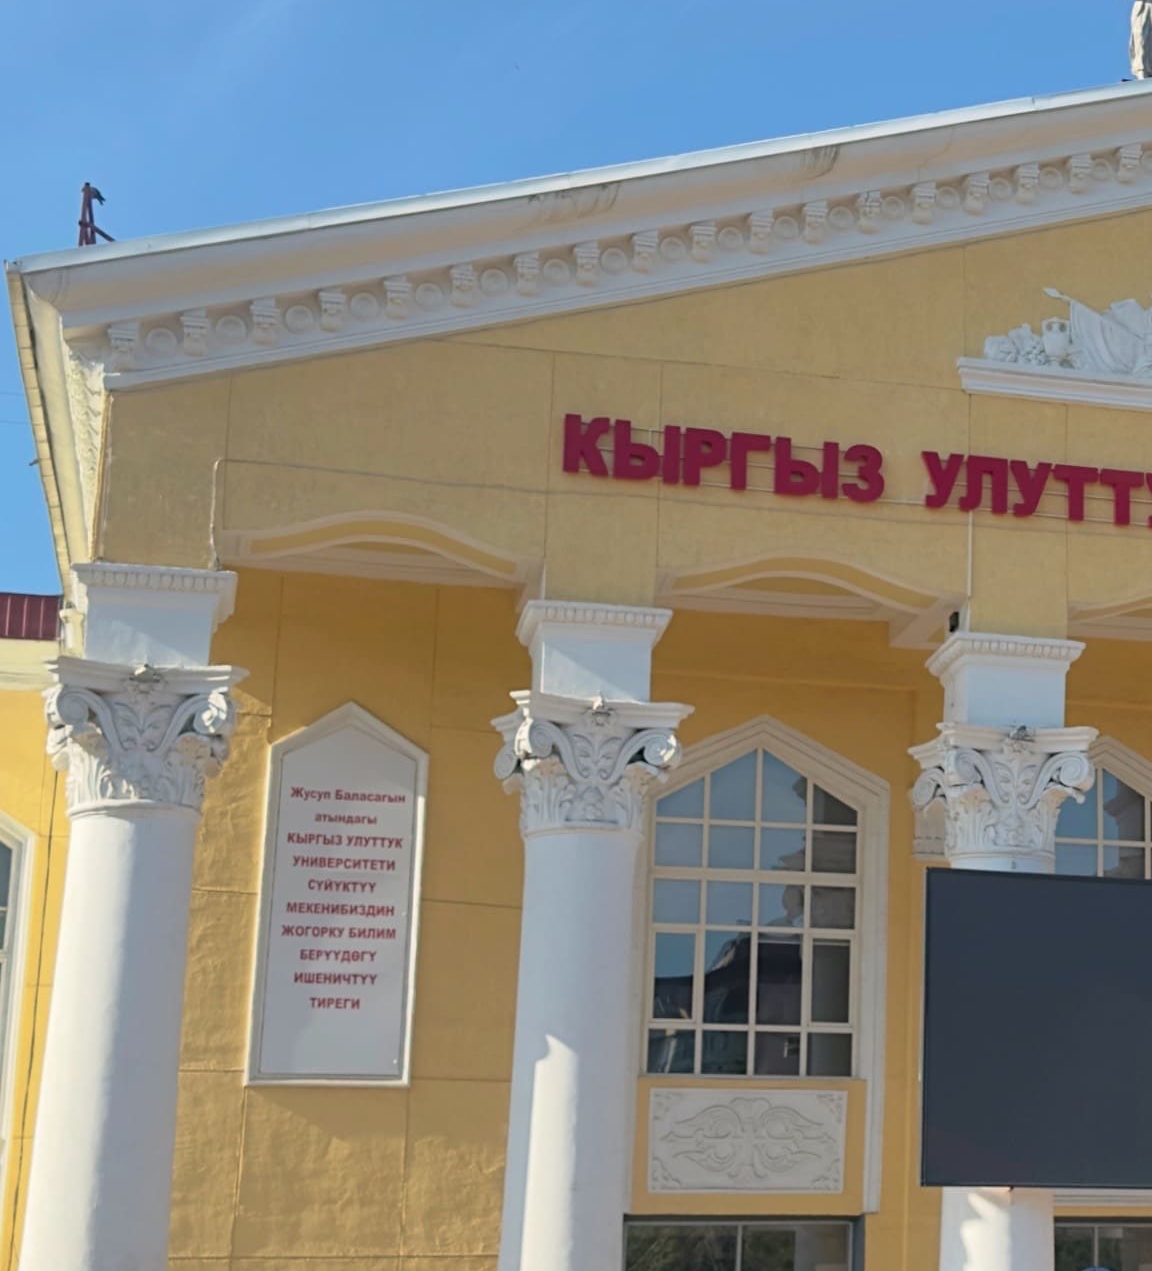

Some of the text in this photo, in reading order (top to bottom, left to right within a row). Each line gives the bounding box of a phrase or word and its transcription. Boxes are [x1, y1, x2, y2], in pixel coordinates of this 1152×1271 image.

[562, 413, 885, 504] КЫРГЫЗ
[290, 786, 406, 803] Жусуп Баласагын
[314, 813, 378, 825] атындагы
[287, 832, 404, 849] КЫРГЫЗ УЛУТТУК
[292, 855, 396, 871] УНИВЕРСИТЕТИ
[307, 878, 377, 893] СҮЙҮКТҮҮ
[285, 901, 395, 918] МЕКЕНИБИЗДИН
[281, 924, 397, 940] ЖОГОРКУ БИЛИМ
[299, 949, 377, 963] БЕРҮҮДӨГҮ
[293, 972, 378, 986] ИШЕНИЧТҮҮ
[309, 996, 361, 1010] ТИРЕГИ
